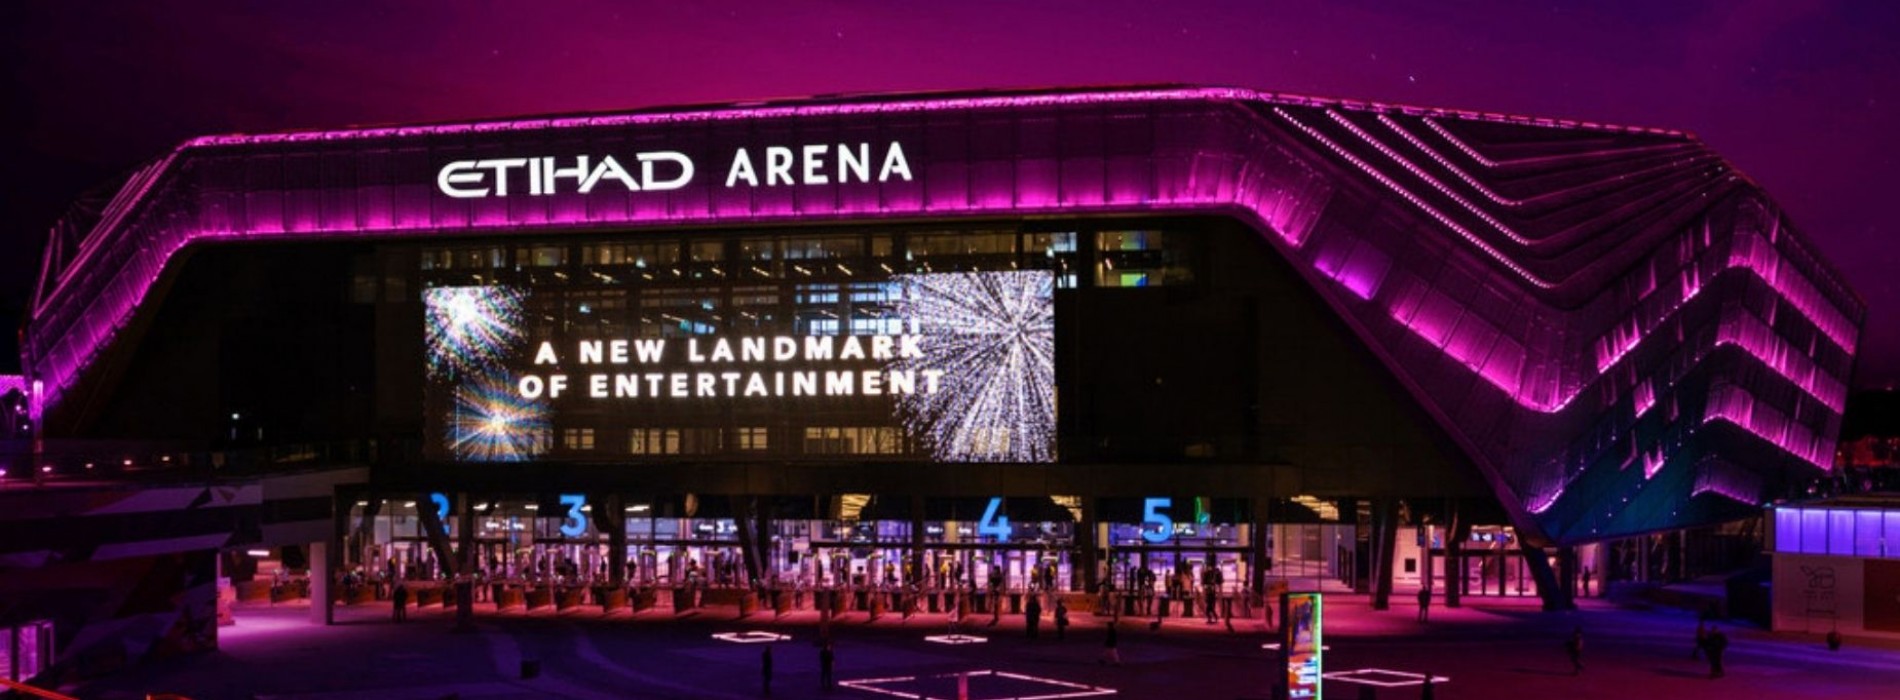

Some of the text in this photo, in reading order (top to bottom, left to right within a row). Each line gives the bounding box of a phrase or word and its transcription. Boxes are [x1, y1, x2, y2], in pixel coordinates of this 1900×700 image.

[437, 141, 913, 198] ETIHAD ARENA
[534, 334, 926, 365] A NEW LANDMARK
[518, 369, 944, 399] OF ENTERTAINMENT
[559, 494, 588, 538] 3
[978, 497, 1013, 544] 4
[1142, 497, 1173, 543] 5
